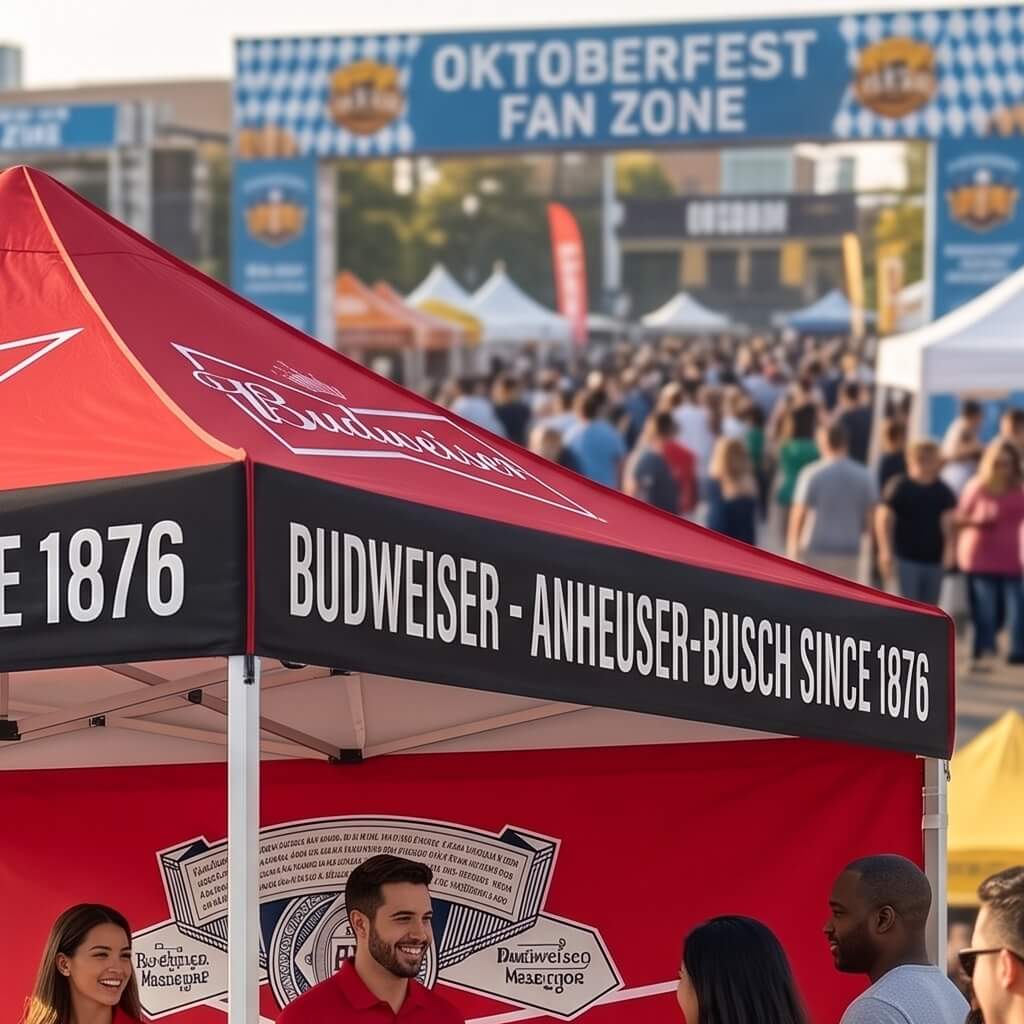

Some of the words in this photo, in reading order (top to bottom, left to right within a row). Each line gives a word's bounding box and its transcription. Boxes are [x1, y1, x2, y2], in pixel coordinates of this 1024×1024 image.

[433, 29, 817, 92] OKTOBERFEST
[500, 92, 596, 140] FAN
[609, 86, 747, 136] ZONE
[192, 369, 528, 481] Budweiser
[39, 520, 185, 624] 1876
[289, 522, 499, 650] BUDWEISER
[531, 573, 791, 700] ANHEUSER-BUSCH
[800, 629, 871, 714] SINCE
[877, 644, 930, 722] 1876
